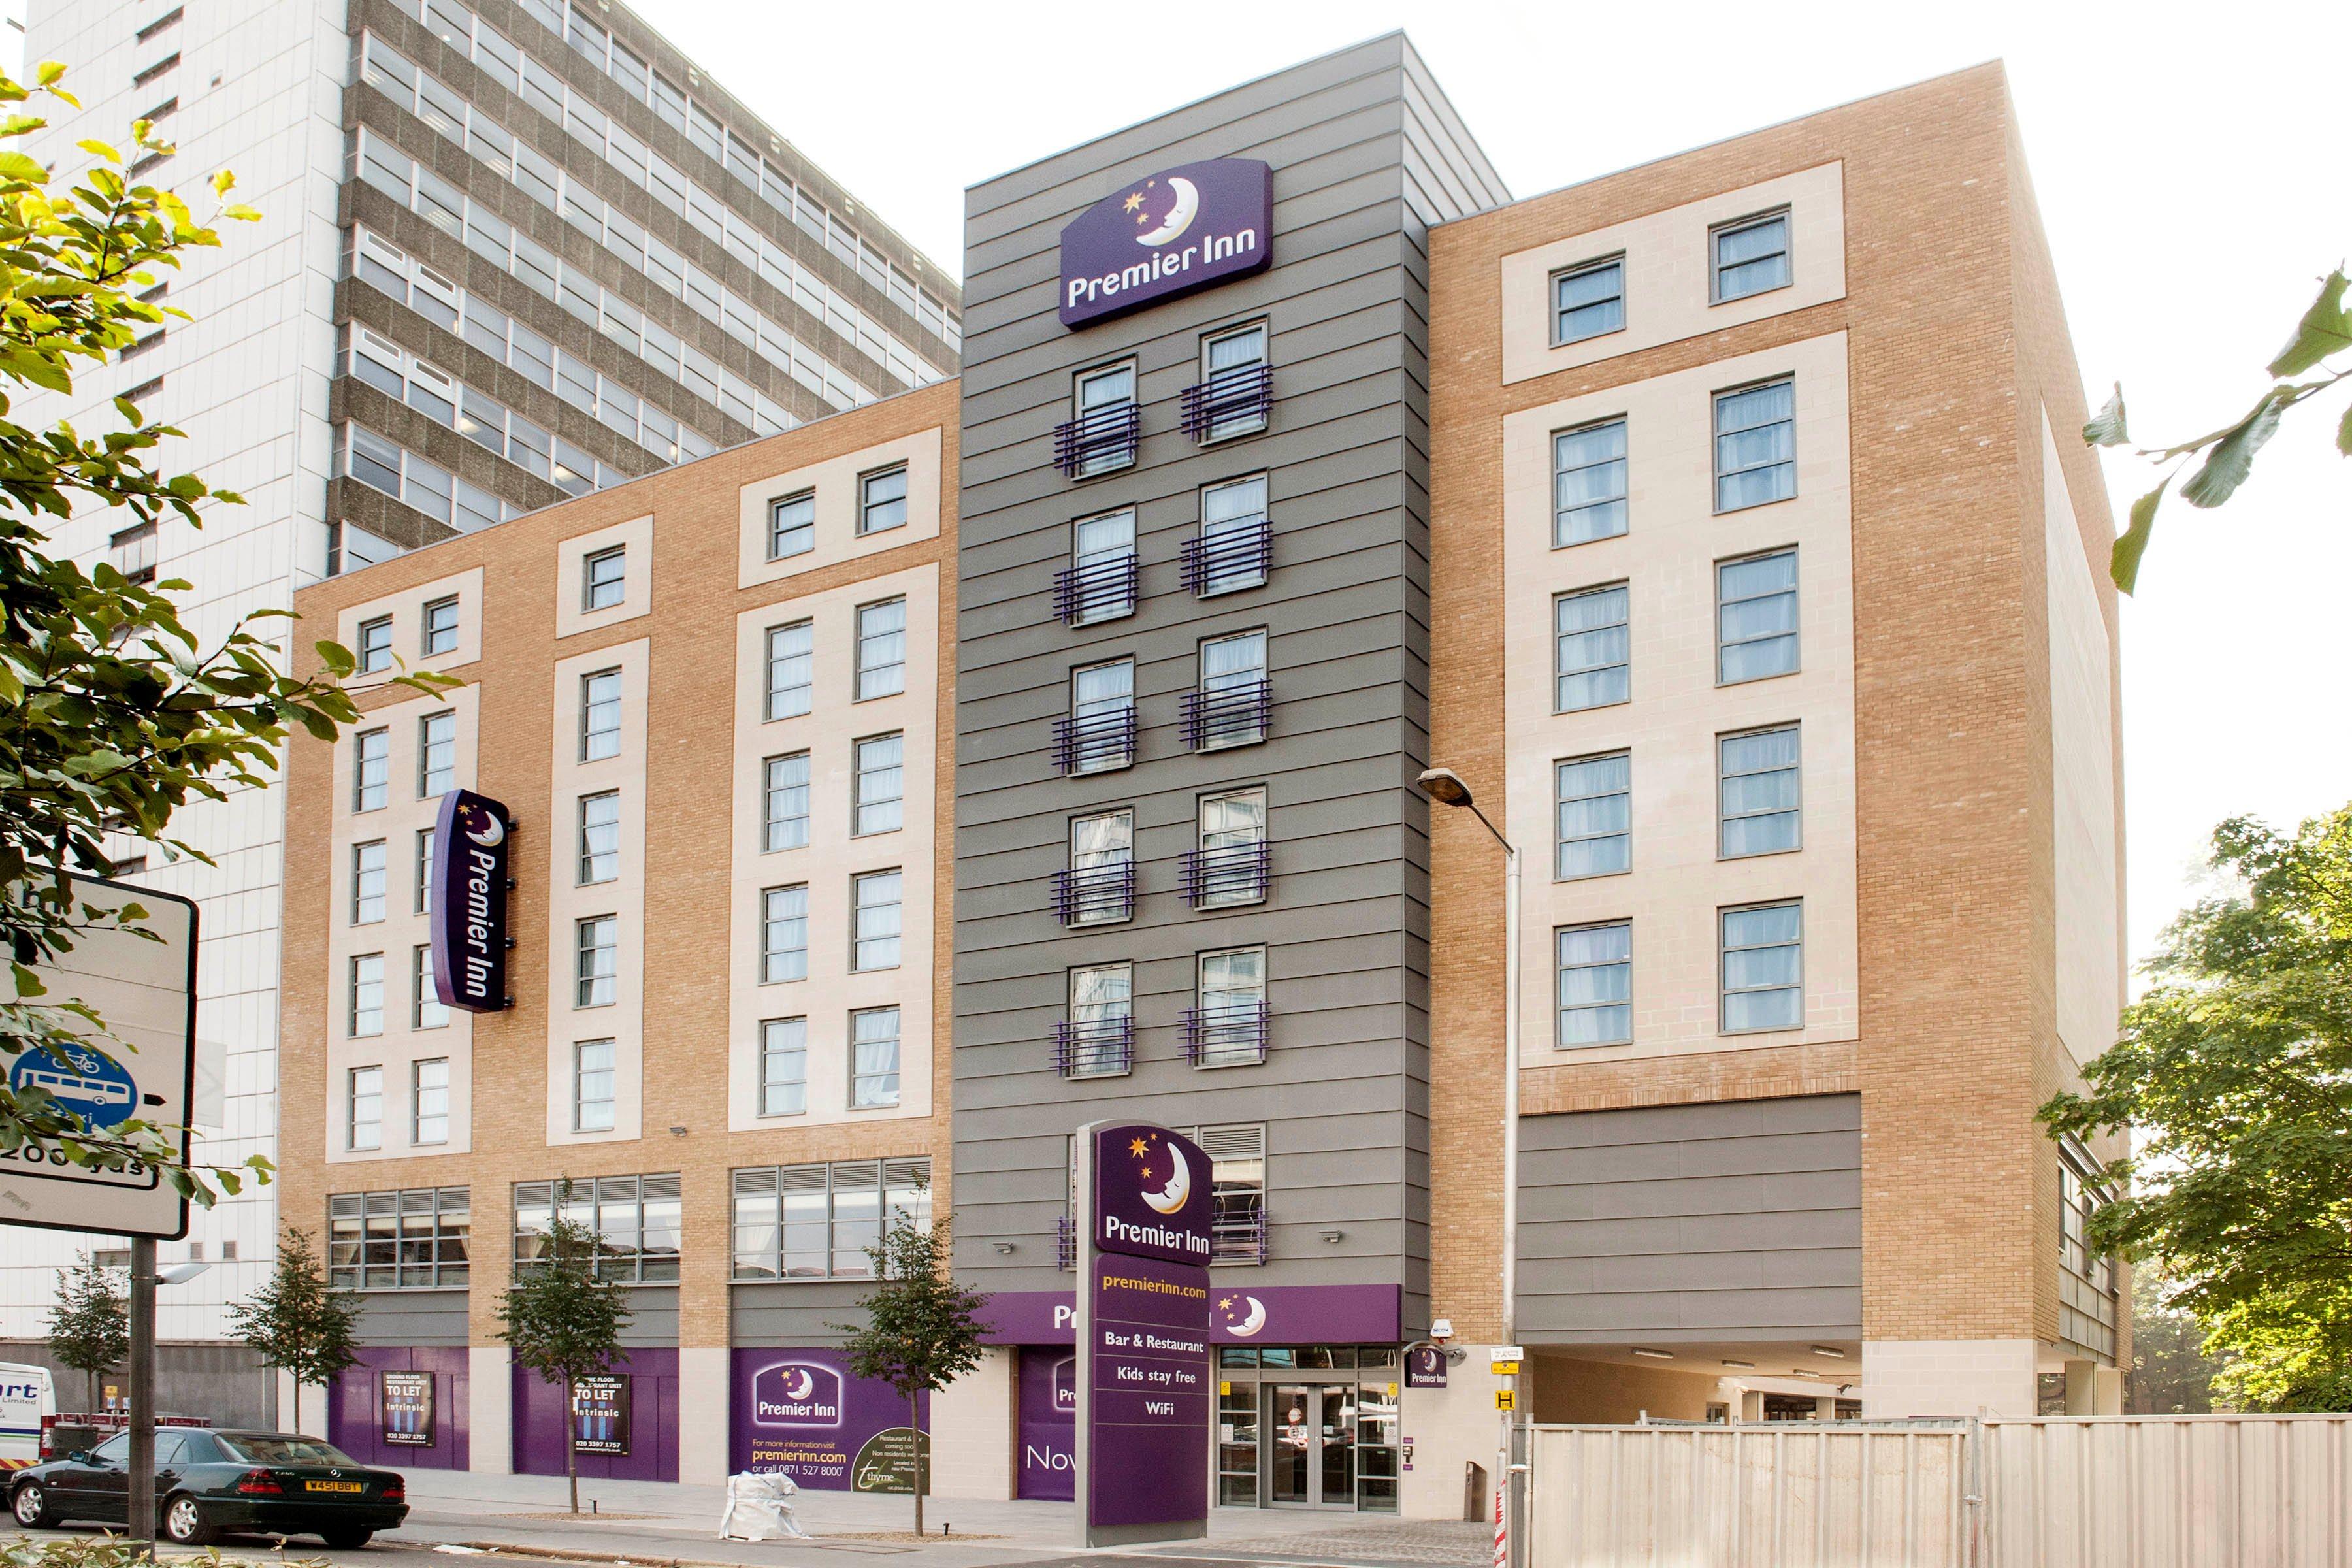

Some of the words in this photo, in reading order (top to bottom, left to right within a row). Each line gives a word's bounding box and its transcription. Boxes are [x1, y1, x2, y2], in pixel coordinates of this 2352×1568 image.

[1068, 247, 1197, 308] Premier
[1203, 229, 1255, 264] Inn
[466, 849, 496, 954] Premier
[466, 956, 493, 998] Inn
[1105, 1215, 1183, 1249] Premier
[1186, 1230, 1209, 1255] Inn
[1103, 1275, 1206, 1299] premierinn.com
[1105, 1331, 1130, 1346] Bar
[1133, 1333, 1143, 1347] &
[1147, 1335, 1203, 1352] Restaurant
[1117, 1366, 1143, 1380] Kids
[1148, 1369, 1171, 1386] stay
[1175, 1370, 1196, 1384] free
[1411, 1373, 1437, 1382] Premier
[1437, 1373, 1446, 1383] Inn
[386, 1385, 400, 1396] TO
[403, 1386, 421, 1396] LET
[575, 1389, 591, 1400] TO
[594, 1390, 615, 1401] LET
[1498, 1392, 1512, 1408] H
[759, 1401, 813, 1416] Premier
[814, 1403, 836, 1416] Inn
[1145, 1401, 1174, 1416] WiFi
[784, 1440, 822, 1448] information
[752, 1449, 847, 1463] premierinn.com
[764, 1465, 777, 1473] call
[779, 1464, 798, 1475] 0871
[802, 1465, 819, 1475] 527
[867, 1472, 894, 1482] thyme
[310, 1482, 335, 1490] W451
